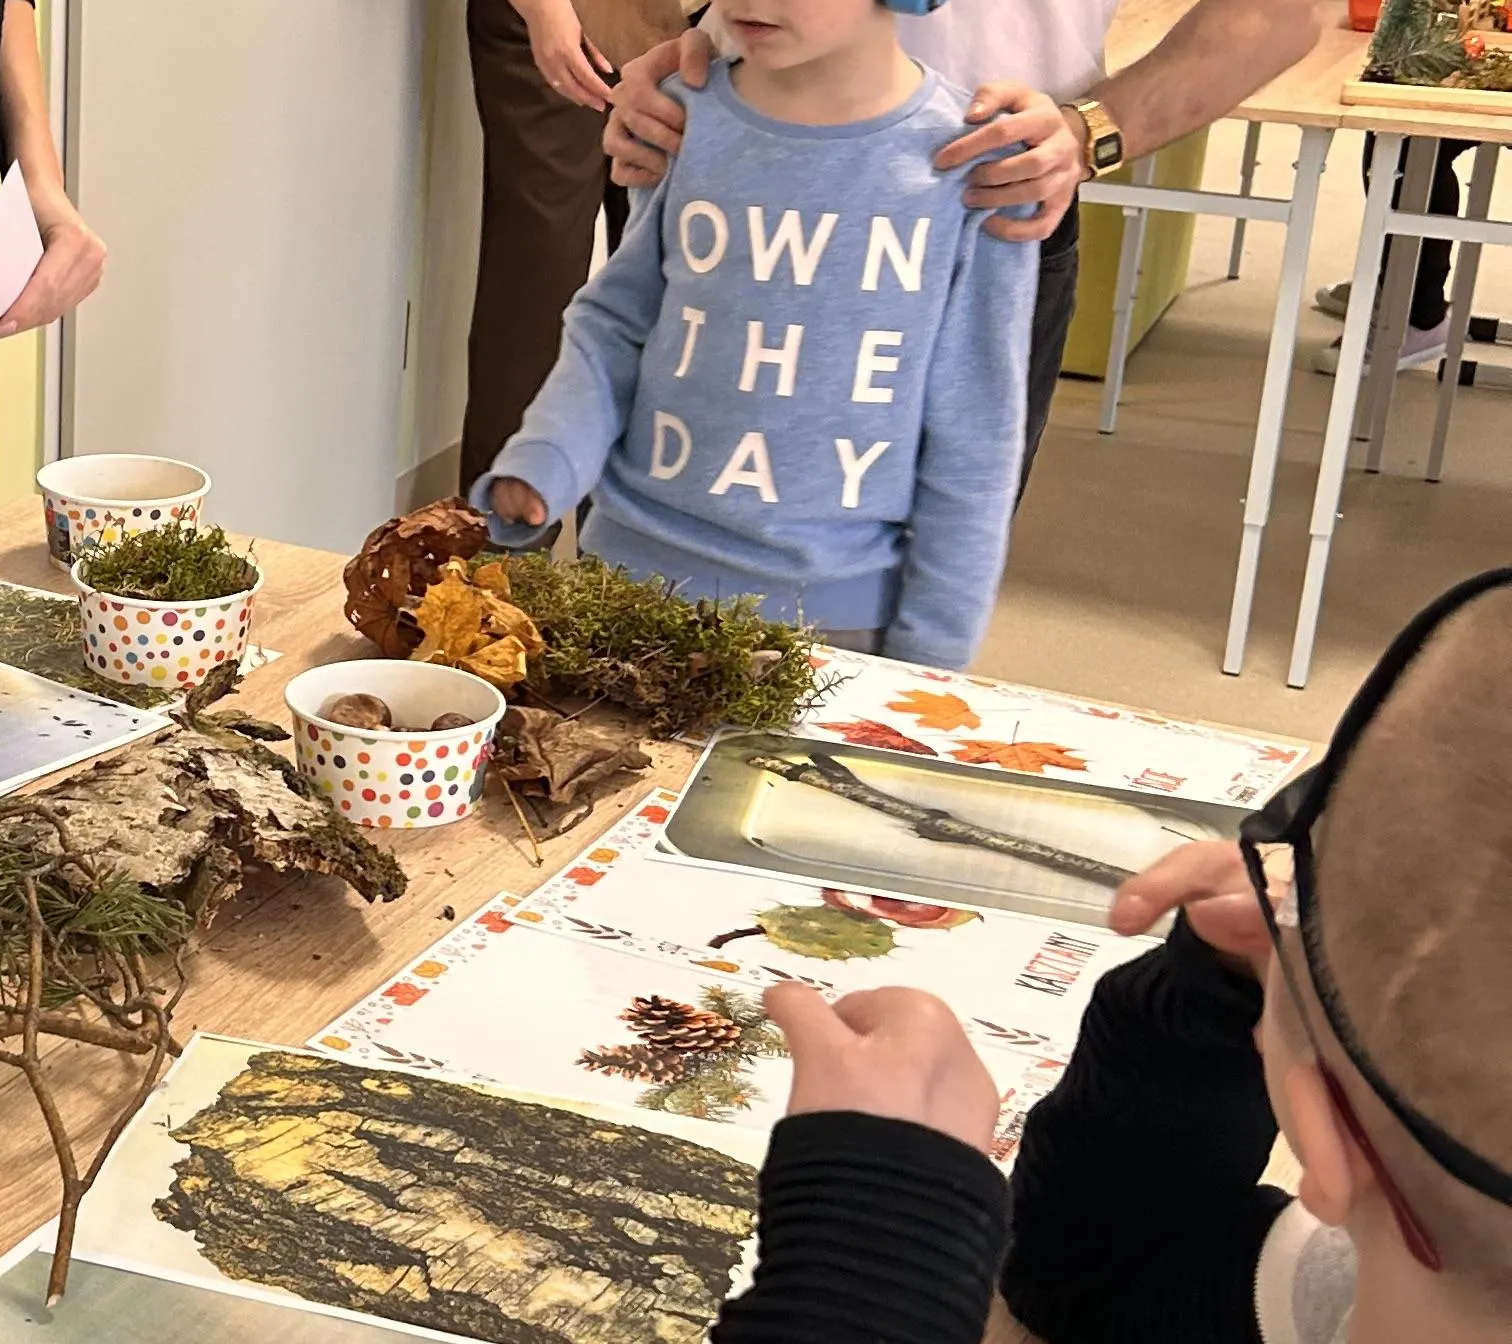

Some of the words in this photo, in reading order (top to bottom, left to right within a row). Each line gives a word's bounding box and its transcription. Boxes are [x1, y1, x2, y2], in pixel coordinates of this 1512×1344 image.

[678, 200, 931, 292] OWN
[673, 306, 904, 404] THE
[649, 410, 893, 509] DAY
[1013, 931, 1100, 996] KASZTANY
